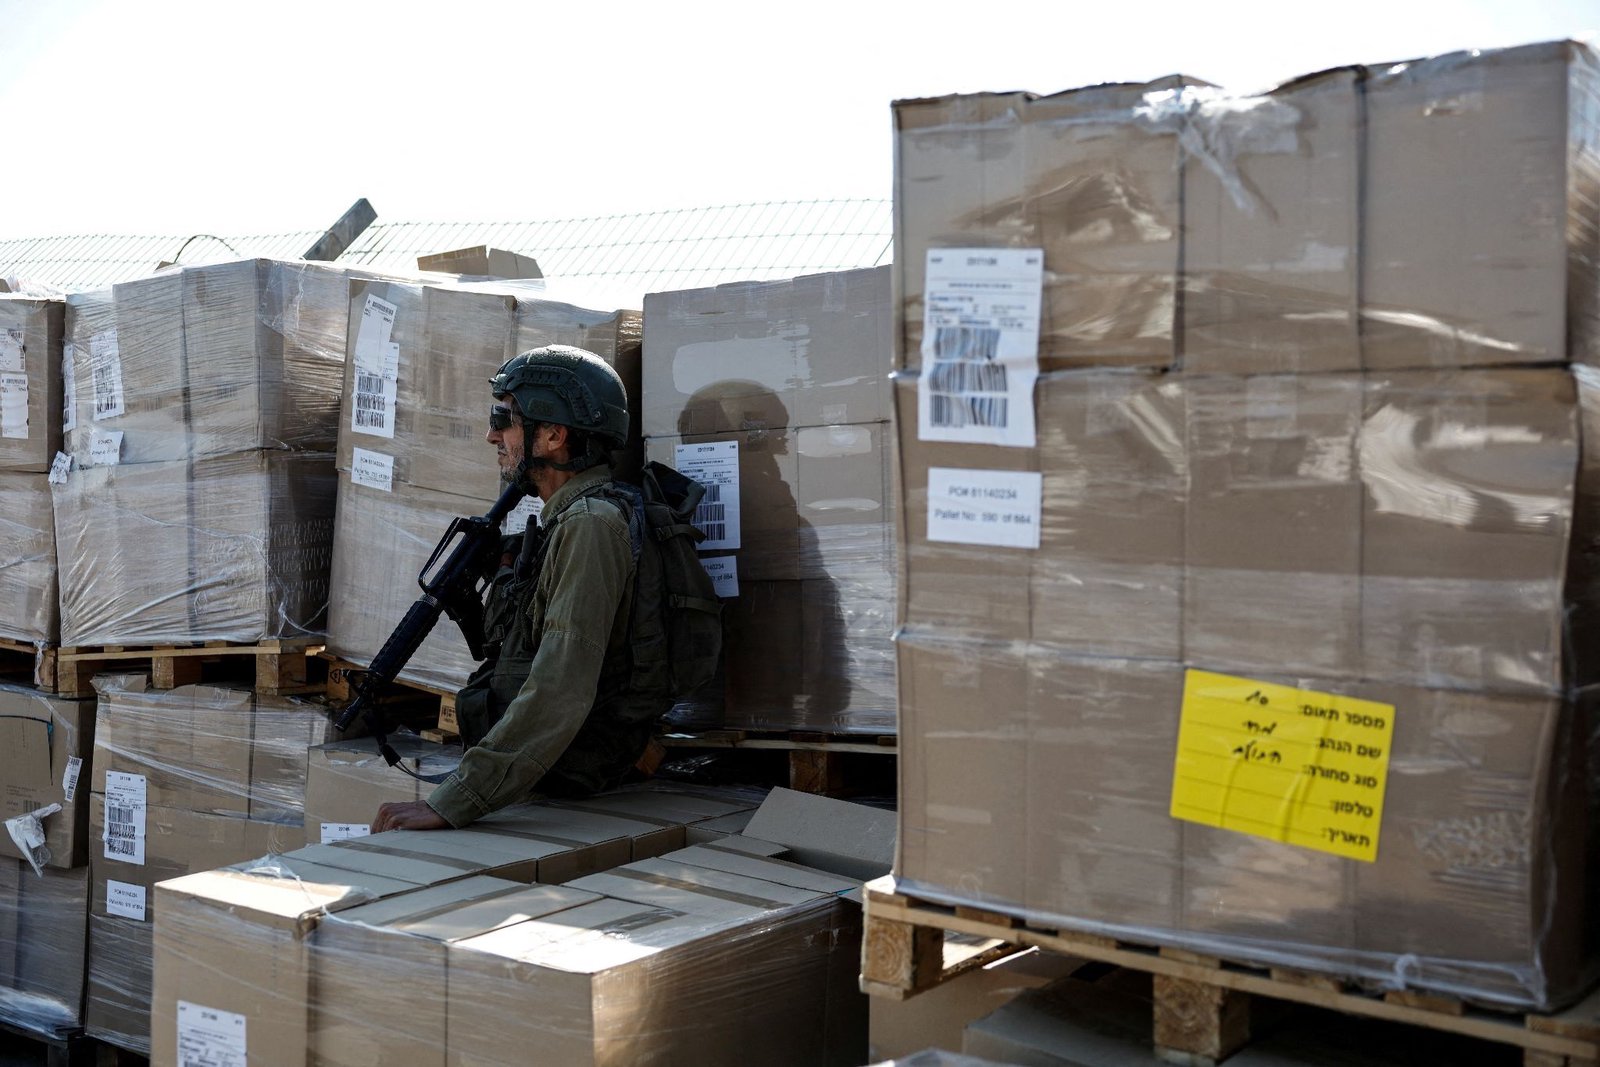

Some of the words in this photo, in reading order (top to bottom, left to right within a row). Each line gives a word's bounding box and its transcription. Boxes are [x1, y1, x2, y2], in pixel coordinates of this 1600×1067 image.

[1345, 711, 1386, 730] מספר
[1357, 744, 1381, 759] שם
[1354, 773, 1378, 789] סוג
[1320, 826, 1370, 848] תאריך:
